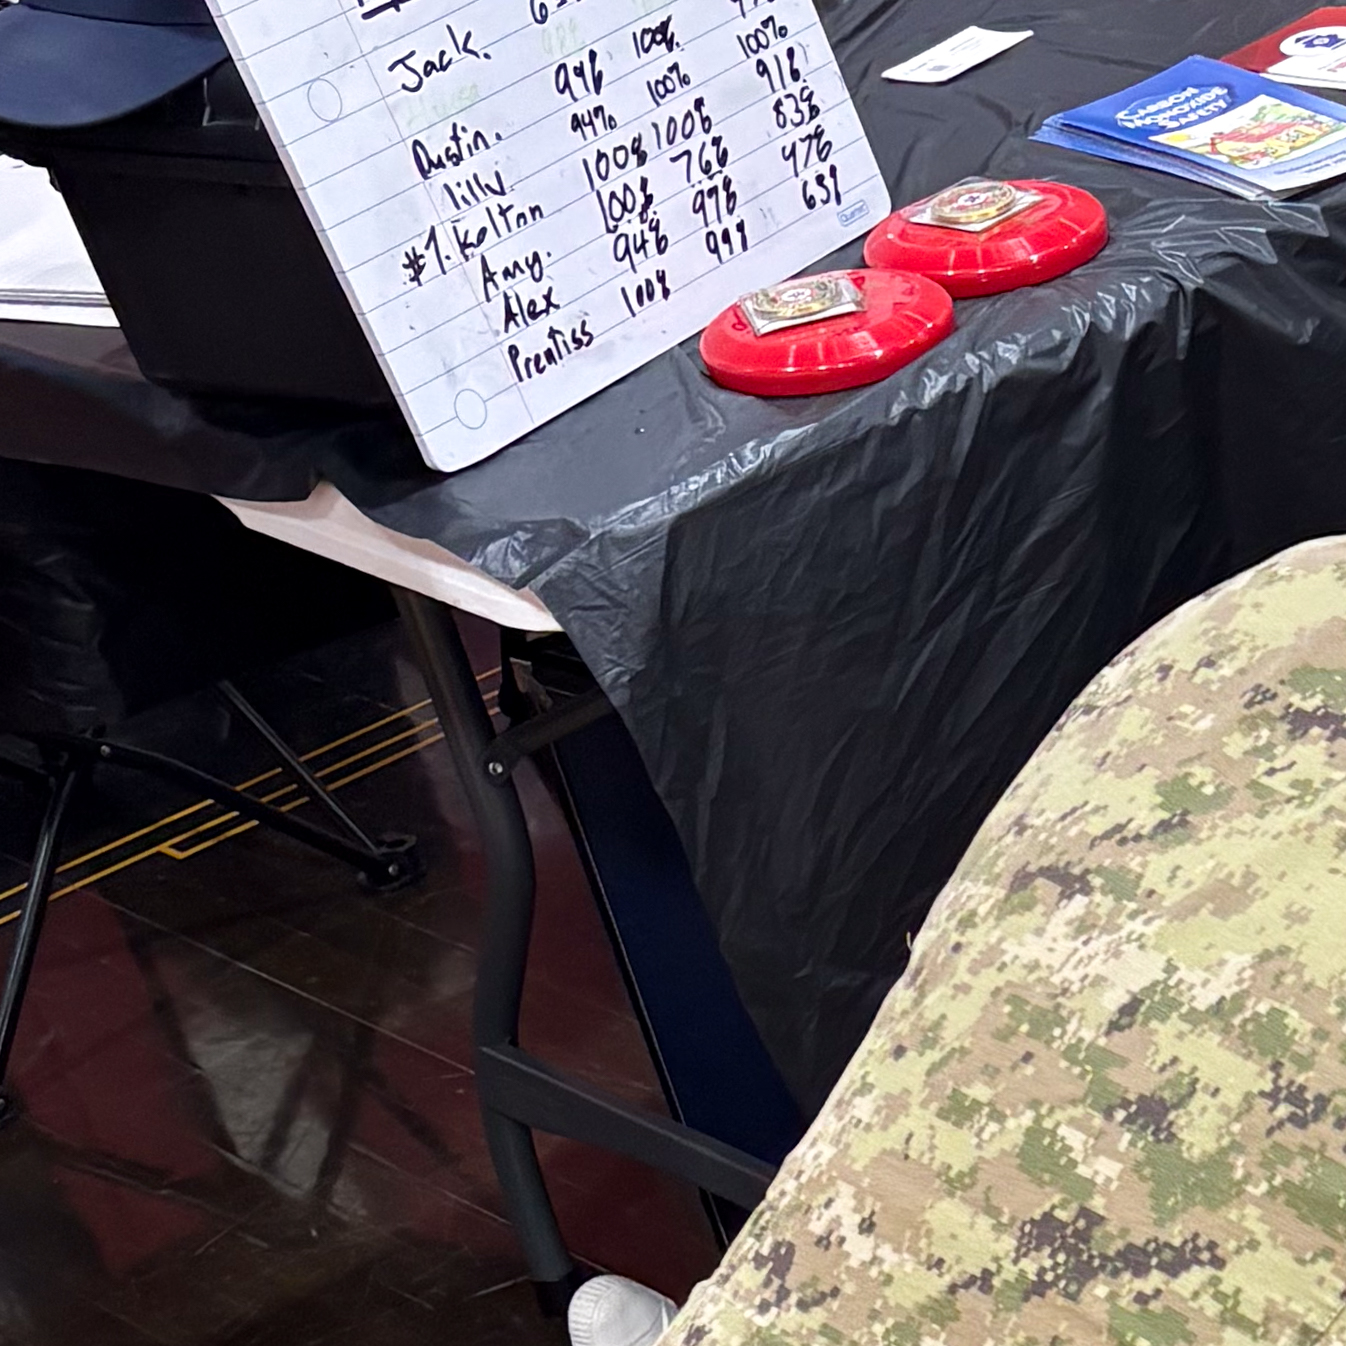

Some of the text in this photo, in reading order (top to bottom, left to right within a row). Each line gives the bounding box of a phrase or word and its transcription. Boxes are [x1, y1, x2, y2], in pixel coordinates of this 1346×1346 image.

[387, 24, 492, 93] Jack.
[646, 61, 691, 107] 100%
[736, 15, 788, 59] 100%
[582, 132, 648, 192] 100%
[651, 96, 712, 151] 100%
[503, 285, 561, 333] Alex
